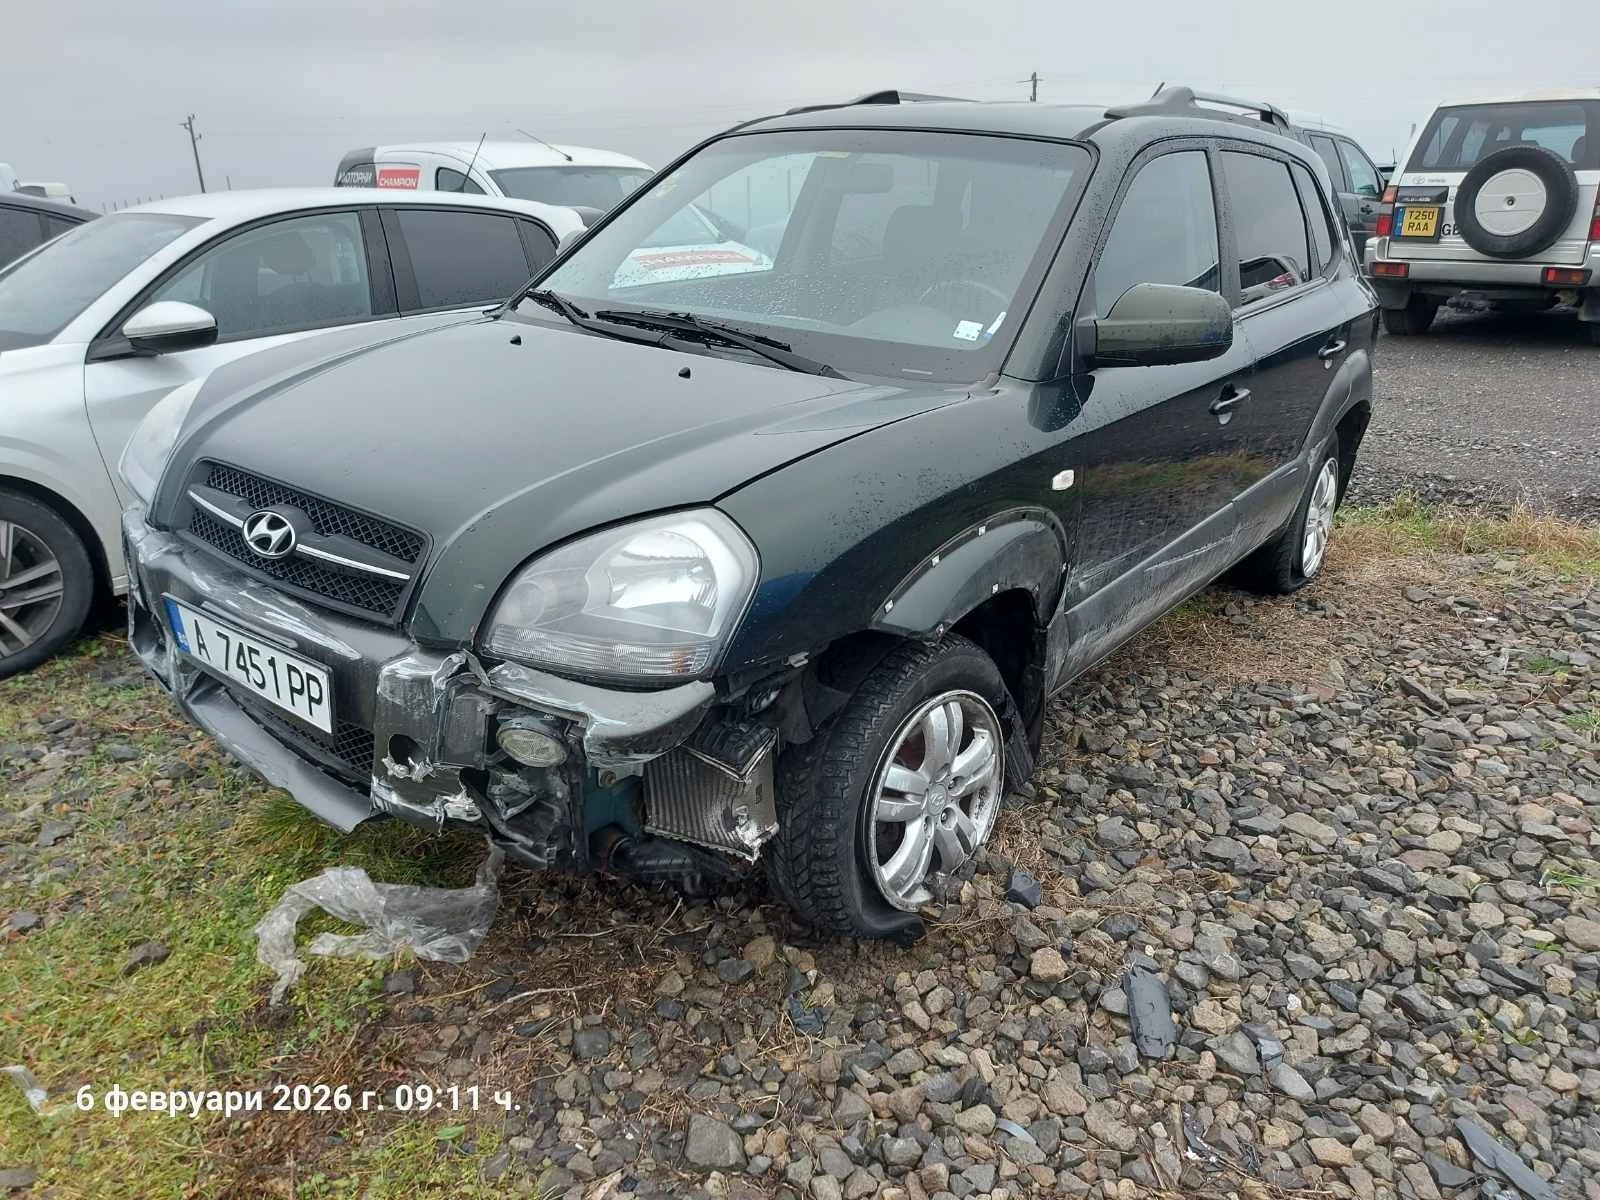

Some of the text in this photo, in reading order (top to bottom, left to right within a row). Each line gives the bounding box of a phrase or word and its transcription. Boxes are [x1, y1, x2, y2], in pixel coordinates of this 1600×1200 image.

[379, 177, 417, 188] CHAMPION
[1409, 211, 1435, 221] T250
[1407, 222, 1429, 232] RAA
[194, 619, 324, 717] A 7451 PP
